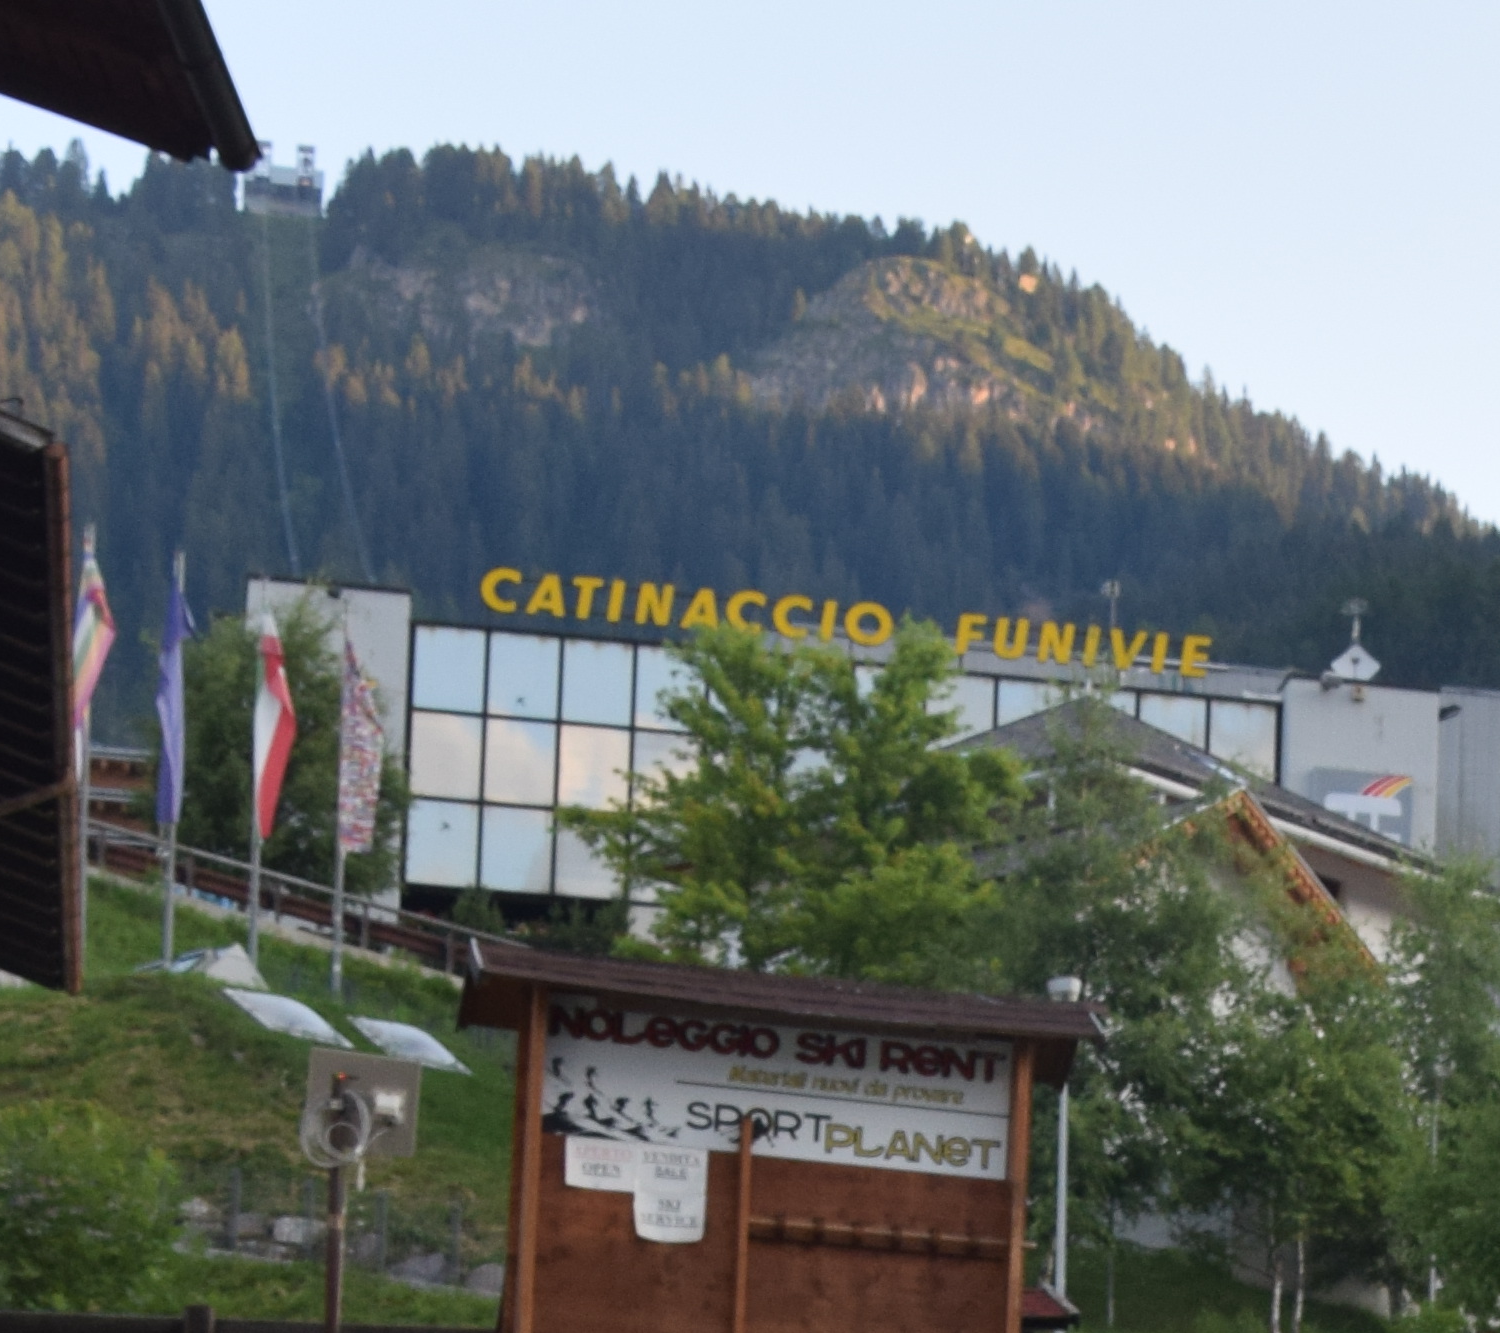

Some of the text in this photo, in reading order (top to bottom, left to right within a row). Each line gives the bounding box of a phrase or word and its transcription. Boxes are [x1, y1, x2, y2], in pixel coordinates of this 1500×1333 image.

[481, 567, 1213, 679] CATINACCIO FUNIVIE
[796, 1030, 866, 1070] SKI
